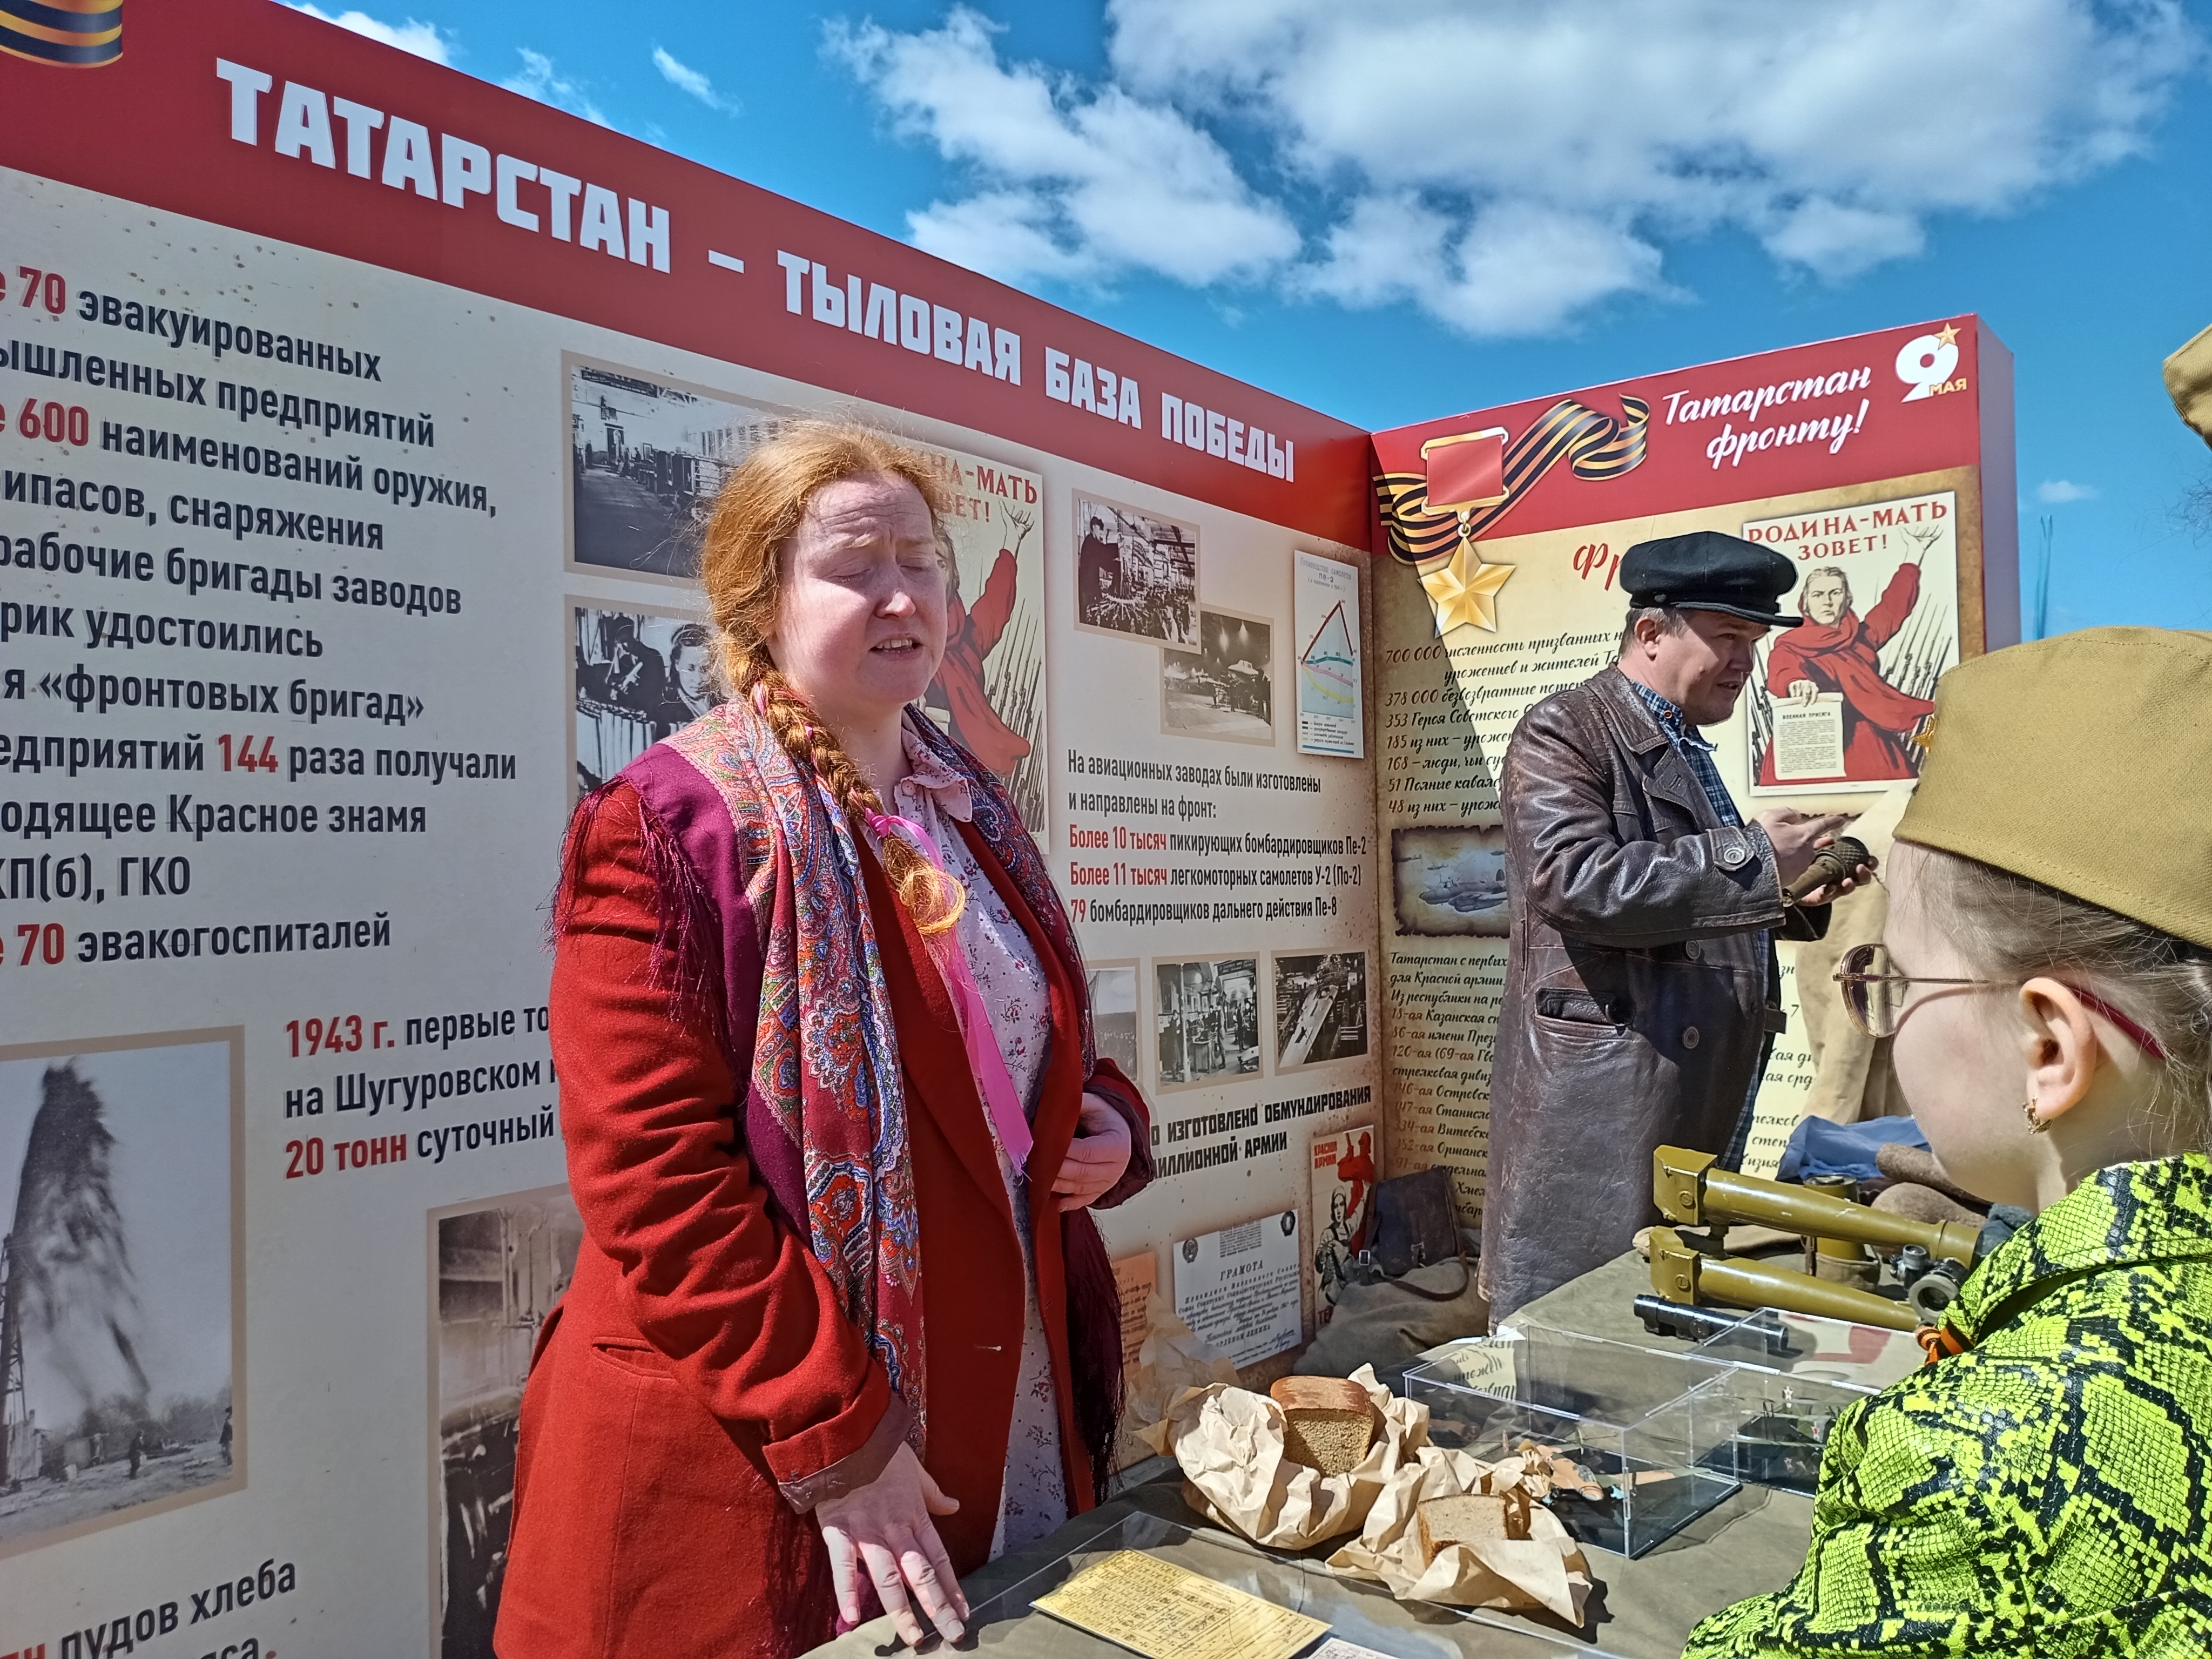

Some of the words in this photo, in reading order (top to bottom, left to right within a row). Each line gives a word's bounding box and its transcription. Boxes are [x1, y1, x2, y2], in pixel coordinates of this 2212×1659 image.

[217, 56, 671, 274] ТАТАРСТАН
[777, 250, 1021, 386] ТЫЛОВАЯ
[1046, 346, 1142, 429] БАЗА
[1162, 392, 1294, 482] ПОБЕДЫ
[19, 266, 66, 314] 70
[79, 291, 382, 382] эвакуированных
[1895, 334, 1959, 403] 9
[1929, 377, 1967, 396] МАЯ
[1662, 366, 1871, 425] Татарстан
[218, 381, 434, 448] предприятий
[1706, 399, 1870, 470] фронту!
[20, 398, 89, 446] 600
[103, 421, 362, 491] наименований
[374, 468, 496, 518] оружия,
[5, 469, 157, 527] ипасов,
[171, 494, 383, 551] снаряжения
[1748, 501, 1947, 543] РОДИНА-МАТЬ
[1798, 534, 1887, 561] ЗОВЕТ!
[167, 548, 321, 602] бригады
[333, 574, 461, 616] заводов
[86, 609, 322, 658] удостоились
[1386, 650, 1410, 664] 700
[1414, 645, 1441, 660] 000
[1444, 641, 1525, 658] численность
[1528, 632, 1610, 656] призванных
[1444, 661, 1517, 686] уроженцев
[1532, 653, 1599, 671] жителей
[40, 663, 278, 715] «фронтовых
[291, 679, 424, 726] бригад»
[1385, 692, 1408, 707] 378
[1411, 689, 1438, 703] 000
[1441, 685, 1536, 707] безвозвратные
[1385, 714, 1408, 729] 353
[1411, 713, 1446, 730] Героя
[1450, 709, 1519, 724] Советского
[218, 734, 278, 772] 144
[291, 746, 363, 781] раза
[377, 747, 516, 785] получали
[1387, 735, 1407, 749] 185
[1410, 738, 1422, 753] из
[1426, 737, 1449, 747] них
[1069, 749, 1084, 774] На
[1089, 756, 1172, 781] авиационных
[1175, 764, 1222, 787] заводах
[1225, 766, 1253, 788] были
[1256, 773, 1321, 793] изготовлены
[1387, 757, 1408, 771] 168
[1422, 758, 1460, 774] люди,
[1465, 757, 1483, 766] чьи
[1388, 779, 1401, 792] 51
[1404, 777, 1452, 792] Полные
[171, 793, 318, 841] Красное
[329, 804, 426, 833] знамя
[1068, 792, 1077, 811] и
[1080, 792, 1157, 820] направлены
[1161, 798, 1175, 816] на
[1178, 795, 1217, 821] фронт:
[1389, 799, 1404, 814] 48
[1407, 802, 1420, 819] из
[1422, 802, 1446, 812] них
[1069, 824, 1108, 849] Более
[1112, 826, 1127, 849] 10
[1129, 832, 1166, 851] тысяч
[1170, 832, 1243, 857] пикирующих
[1245, 832, 1344, 859] бомбардировщиков
[1346, 835, 1366, 855] Пе-2
[120, 856, 190, 896] ГКО
[1070, 861, 1109, 886] Более
[1113, 861, 1127, 886] 11
[1130, 867, 1168, 886] тысяч
[1170, 866, 1258, 891] легкомоторных
[1260, 866, 1313, 886] самолетов
[1315, 866, 1331, 886] У-2
[1333, 864, 1361, 887] (По-2)
[1071, 899, 1086, 923] 79
[1090, 900, 1210, 926] бомбардировщиков
[1212, 900, 1263, 923] дальнего
[1266, 898, 1312, 922] действия
[1315, 896, 1337, 917] Пе-8
[18, 923, 64, 965] 70
[78, 913, 390, 963] эвакогоспиталей
[1390, 952, 1458, 969] Татарстан
[1468, 955, 1507, 970] первых
[1390, 974, 1411, 988] для
[1414, 972, 1461, 987] Красной
[1391, 989, 1405, 1007] Из
[1406, 990, 1471, 1008] республики
[1474, 996, 1488, 1004] на
[286, 1015, 362, 1057] 1943
[373, 1021, 395, 1049] г.
[406, 1009, 515, 1050] первые
[1426, 1009, 1484, 1027] Казанская
[1428, 1032, 1464, 1041] имени
[286, 1087, 323, 1118] на
[336, 1061, 539, 1116] Шугуровском
[1393, 1067, 1458, 1080] стрелковая
[1168, 1107, 1258, 1143] ИЗГОТОВЛЕНО
[1264, 1085, 1371, 1123] ОБМУНДИРОВАНИЯ
[286, 1138, 323, 1179] 20
[334, 1134, 407, 1171] тонн
[417, 1105, 554, 1163] суточный
[1244, 1131, 1287, 1159] АРМИИ
[1220, 1260, 1263, 1281] ГРАМОТА
[62, 1601, 178, 1659] пудов
[191, 1559, 295, 1624] хлеба
